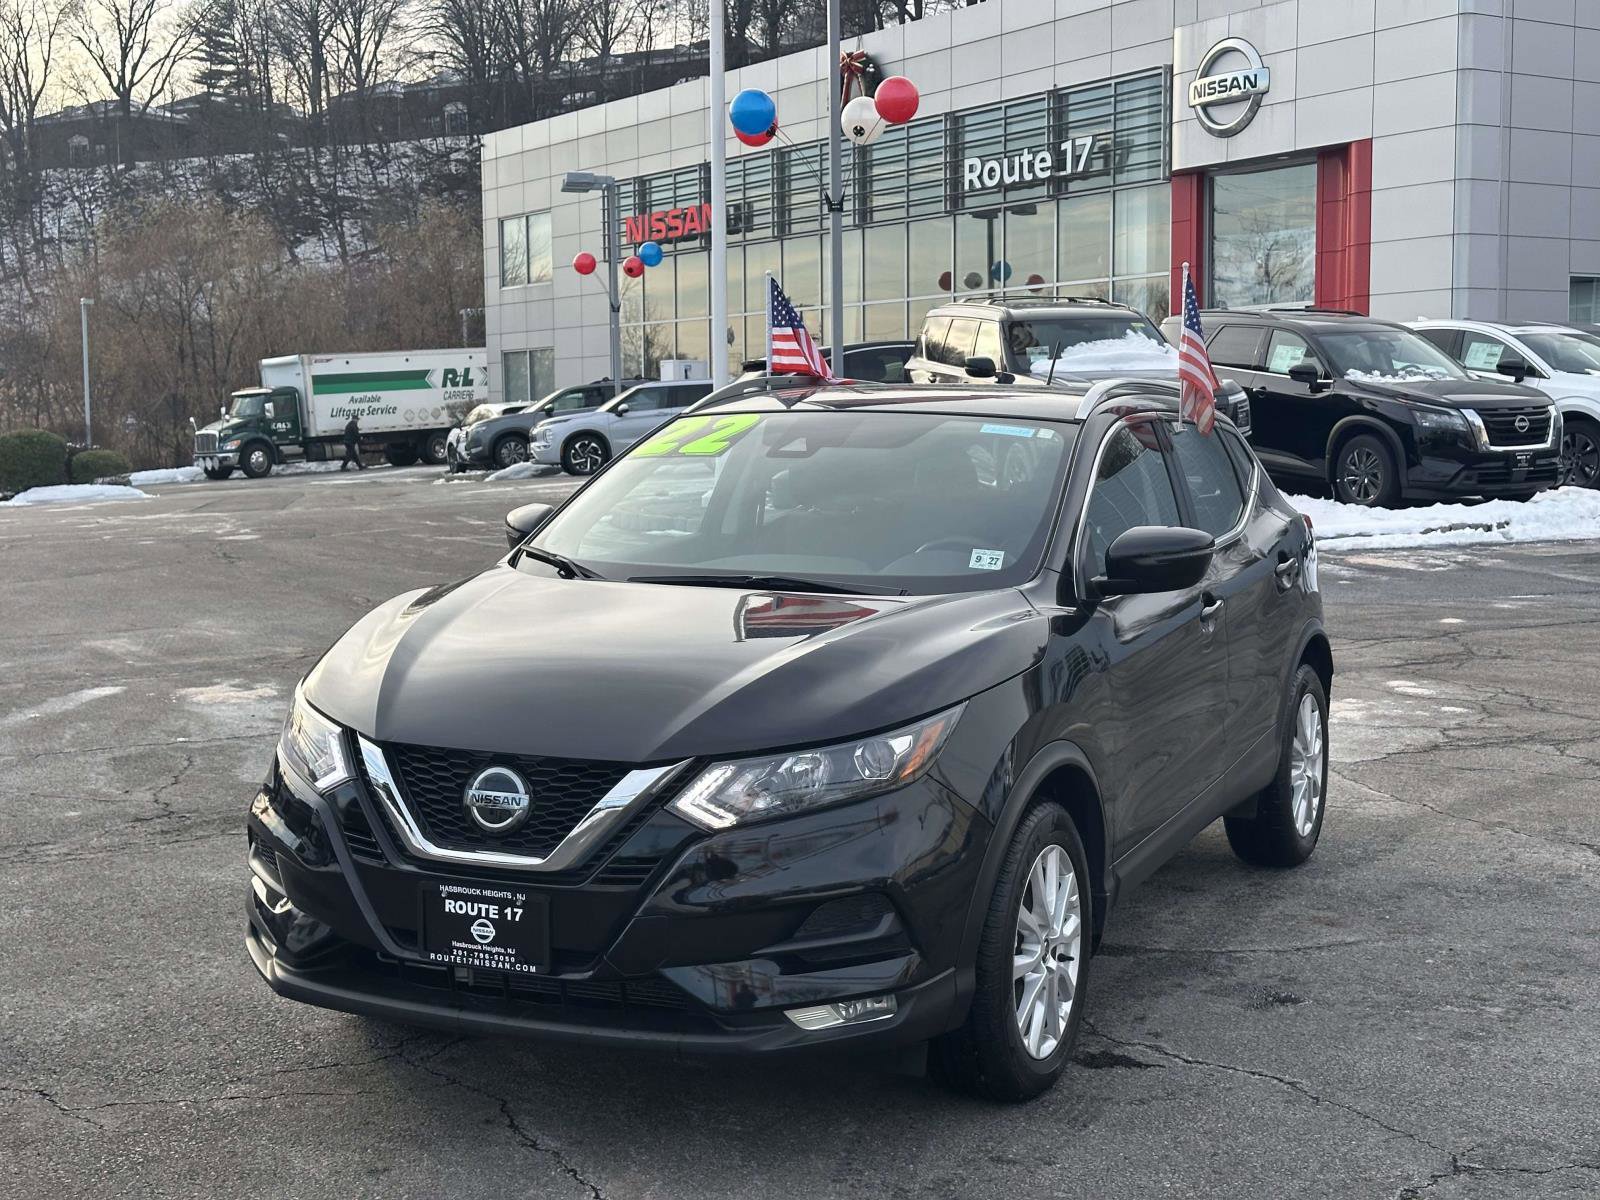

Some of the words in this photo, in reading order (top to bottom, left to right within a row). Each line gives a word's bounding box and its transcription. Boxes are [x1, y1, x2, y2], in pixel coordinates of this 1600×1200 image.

[1193, 74, 1257, 100] NISSAN
[964, 147, 1052, 190] Route
[1056, 136, 1092, 175] 17
[348, 395, 381, 404] Available
[330, 407, 365, 420] Liftgate
[367, 405, 397, 416] Service
[632, 414, 760, 455] 22
[975, 555, 982, 563] 9
[988, 556, 1000, 565] 27
[472, 794, 521, 806] NISSAN
[440, 885, 481, 895] HASBROUCK
[445, 899, 499, 918] ROUTE
[504, 907, 523, 921] 17
[452, 941, 482, 950] Hasbrouck
[430, 953, 536, 972] ROUTE17NISSAN.COM
